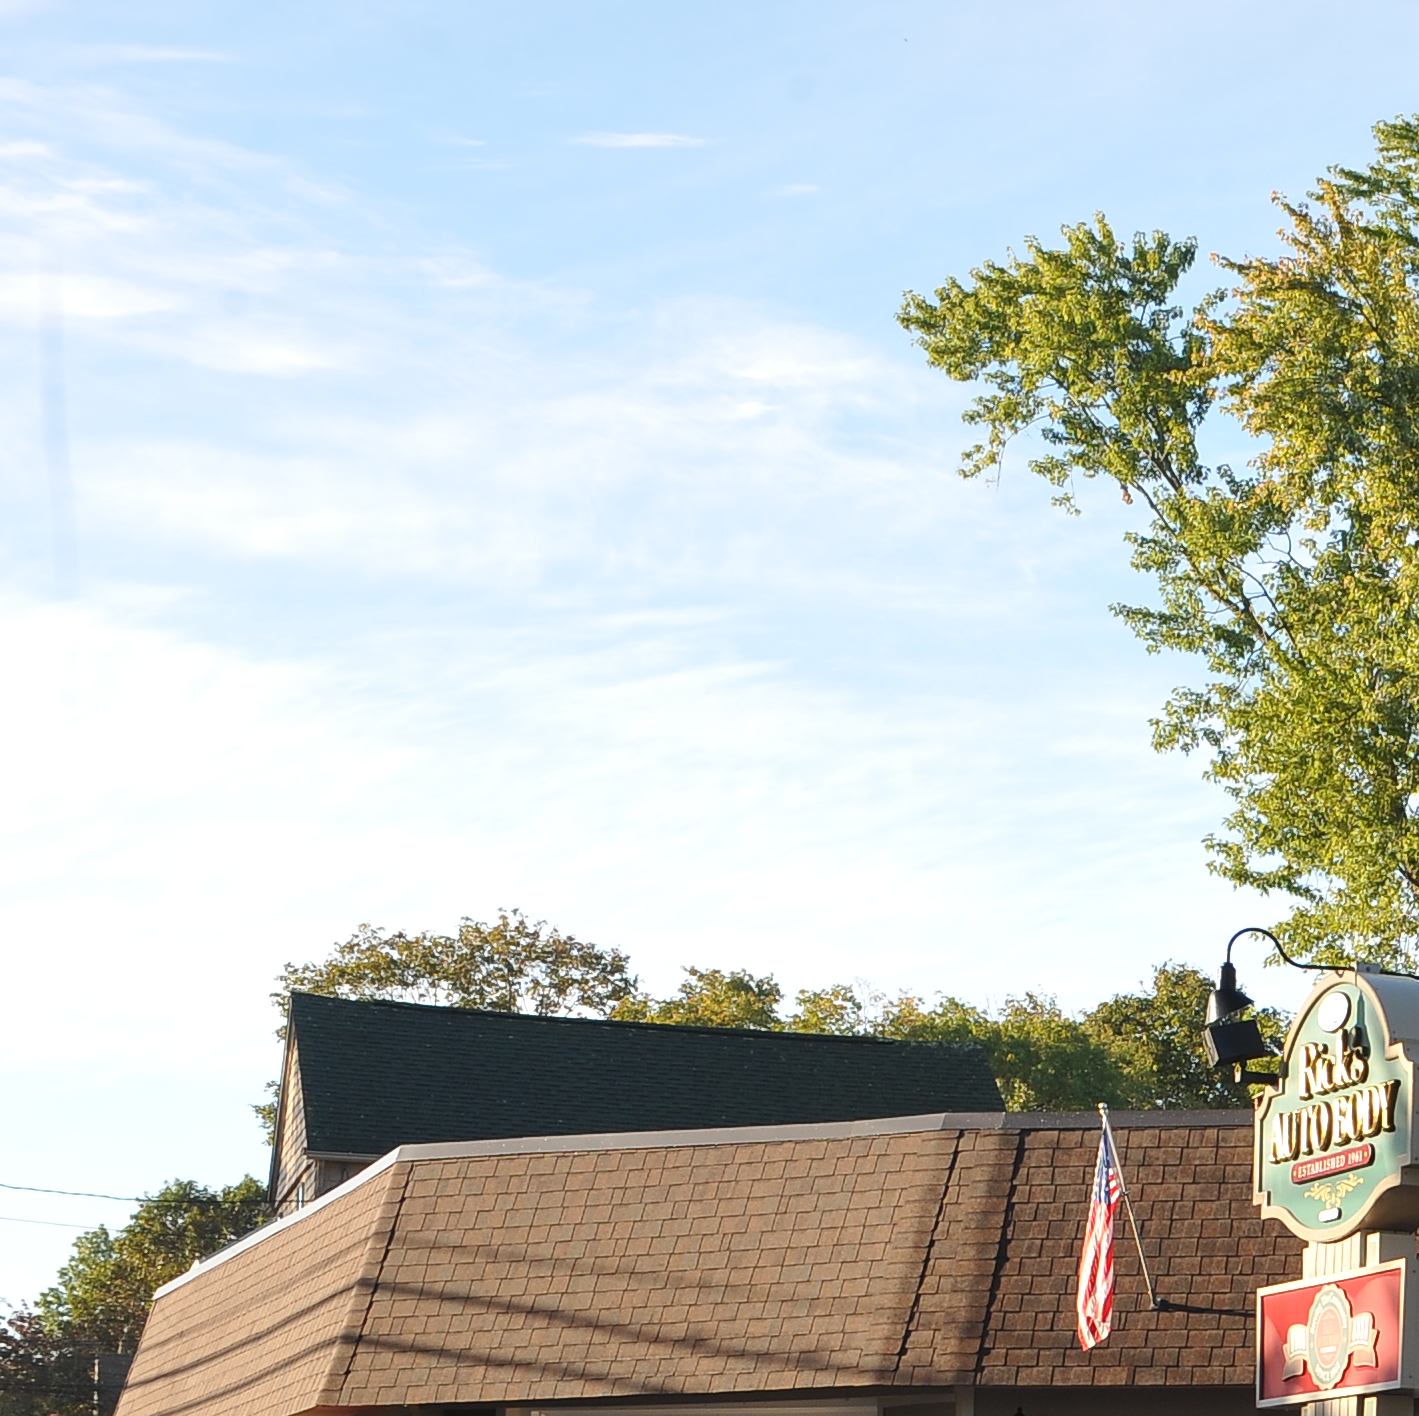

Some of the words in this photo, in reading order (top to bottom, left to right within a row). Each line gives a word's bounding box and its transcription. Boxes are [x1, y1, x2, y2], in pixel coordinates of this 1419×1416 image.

[1268, 1101, 1333, 1164] AUTO
[1332, 1079, 1401, 1146] BODY
[1297, 1154, 1346, 1179] ESTABLISHED
